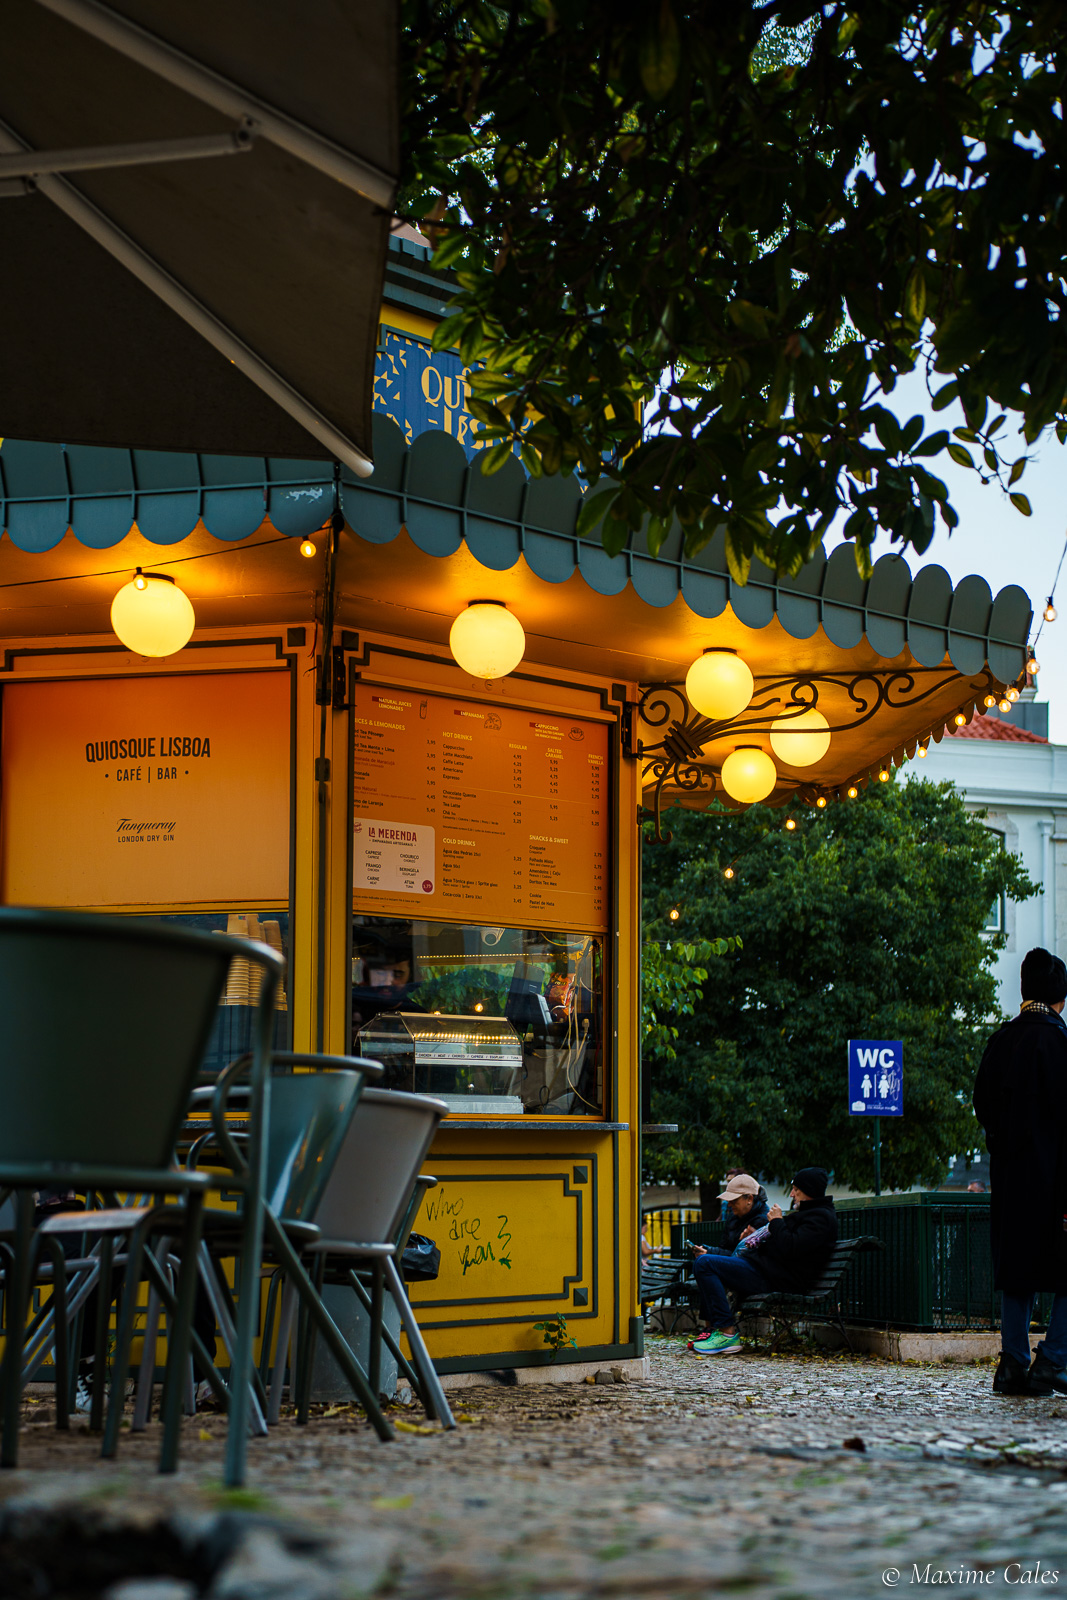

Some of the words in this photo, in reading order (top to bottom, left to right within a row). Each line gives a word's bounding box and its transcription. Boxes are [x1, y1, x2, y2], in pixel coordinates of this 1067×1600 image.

[461, 711, 484, 719] EMPANADAS
[374, 721, 405, 730] LEMONADES
[535, 723, 559, 731] CAPPUCCINO
[454, 733, 472, 741] DRINKS
[86, 738, 156, 763] QUIOSQUE
[160, 737, 210, 758] LISBOA
[117, 766, 142, 781] CAFÉ
[158, 767, 177, 780] BAR
[116, 818, 176, 834] Tanqueray
[369, 827, 375, 838] LA
[379, 828, 417, 842] MERENDA
[857, 1048, 894, 1068] WC
[449, 1218, 481, 1240] are
